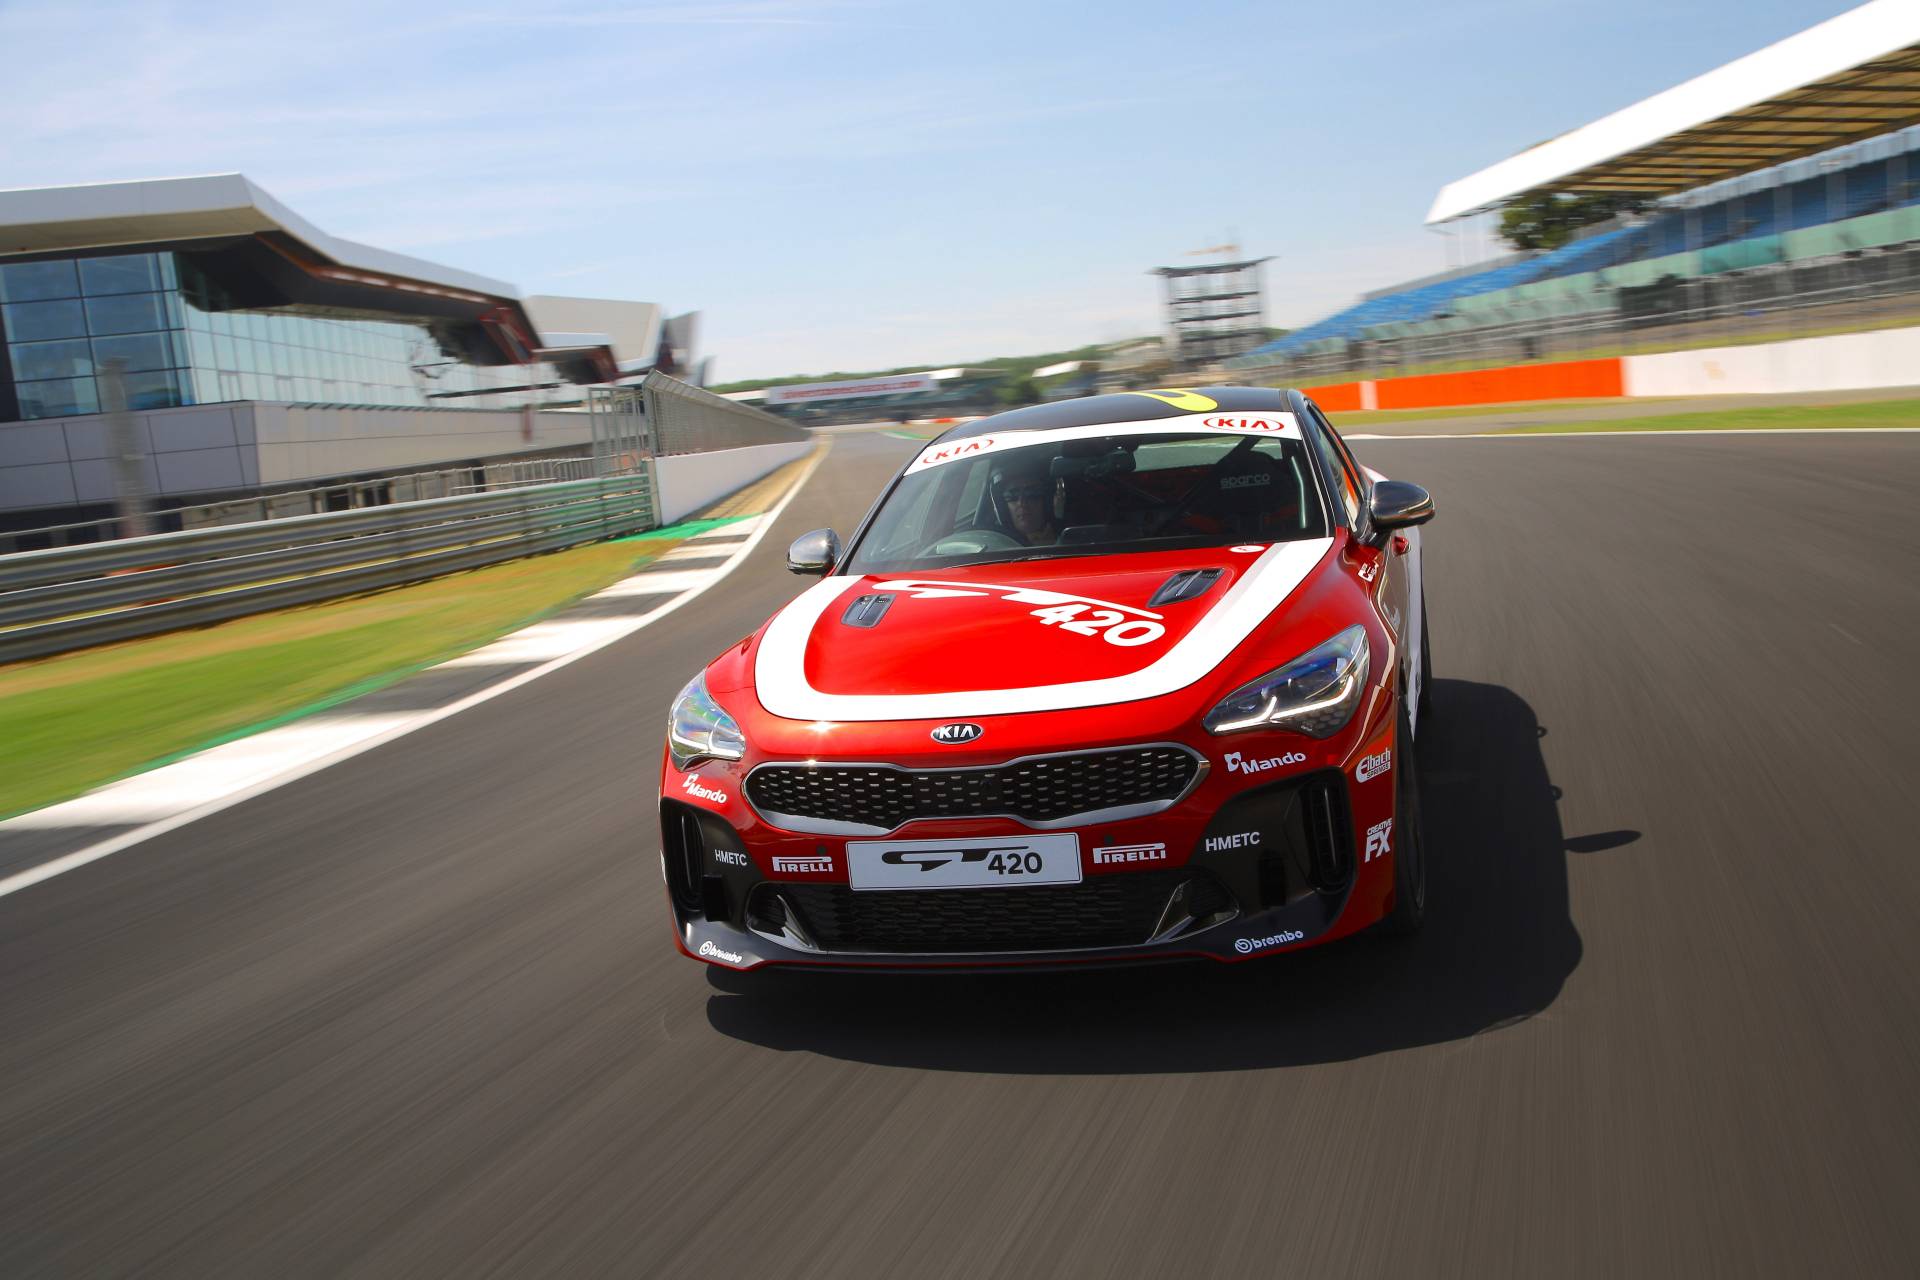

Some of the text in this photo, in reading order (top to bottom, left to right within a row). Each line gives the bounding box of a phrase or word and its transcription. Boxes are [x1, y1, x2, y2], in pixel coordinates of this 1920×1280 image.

[1218, 419, 1269, 429] KIA
[935, 442, 980, 460] KIA
[1220, 473, 1271, 489] sparco
[1029, 604, 1166, 647] 420
[938, 725, 975, 739] KIA
[1241, 752, 1306, 774] Mando
[1356, 747, 1391, 783] Eibach
[687, 783, 727, 804] Mando
[1367, 818, 1392, 835] CREATIVE
[1205, 831, 1260, 852] HMETC
[1365, 826, 1391, 862] FX
[715, 849, 748, 866] HMETC
[987, 852, 1042, 875] 420
[1093, 843, 1167, 864] PIRELLI
[772, 856, 834, 872] PIRELLI
[1252, 930, 1304, 950] brembo
[709, 945, 742, 964] brembo
